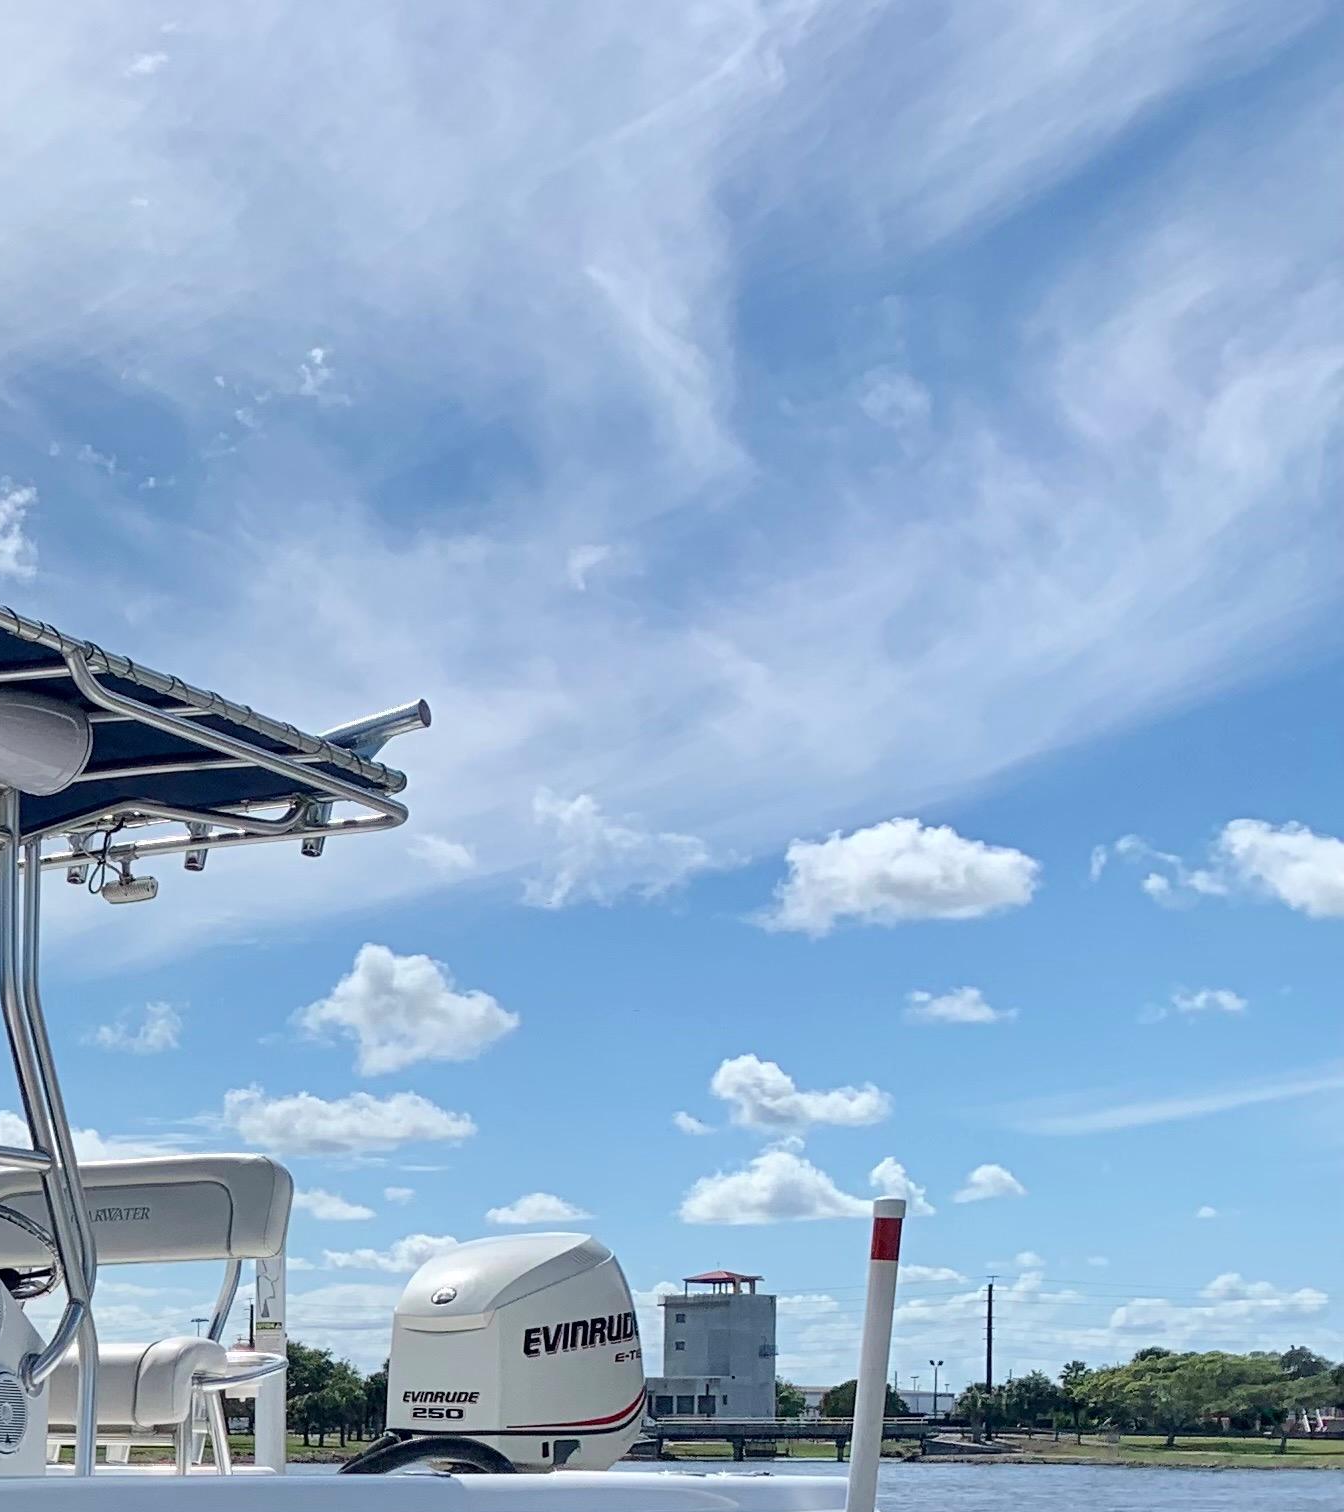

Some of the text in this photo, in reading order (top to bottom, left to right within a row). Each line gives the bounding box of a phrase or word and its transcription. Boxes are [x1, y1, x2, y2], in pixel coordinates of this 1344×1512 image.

[88, 1207, 150, 1223] RWATER
[615, 1349, 641, 1363] E-TE
[402, 1391, 480, 1404] EVINRUDE
[412, 1407, 464, 1420] 250
